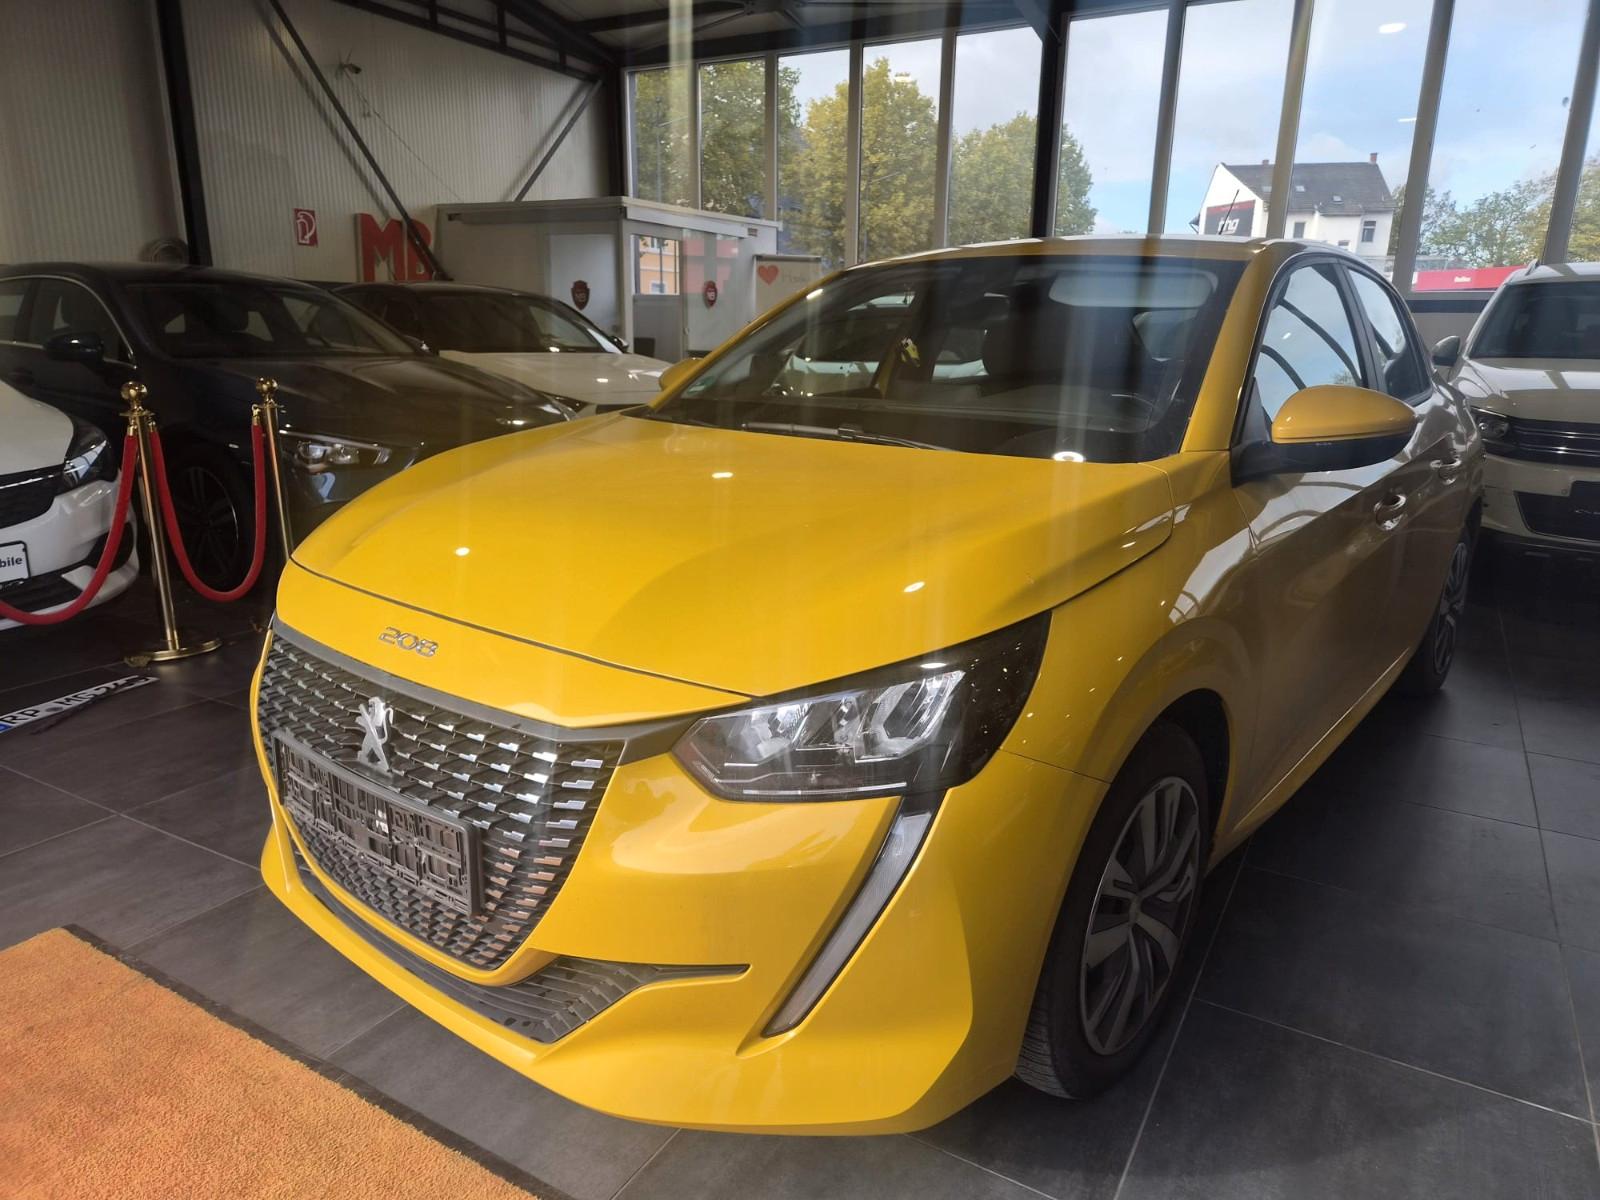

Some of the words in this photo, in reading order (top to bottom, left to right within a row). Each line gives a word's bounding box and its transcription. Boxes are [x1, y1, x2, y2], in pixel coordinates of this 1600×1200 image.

[354, 213, 433, 282] MB
[379, 627, 439, 657] 208
[0, 709, 40, 724] RP
